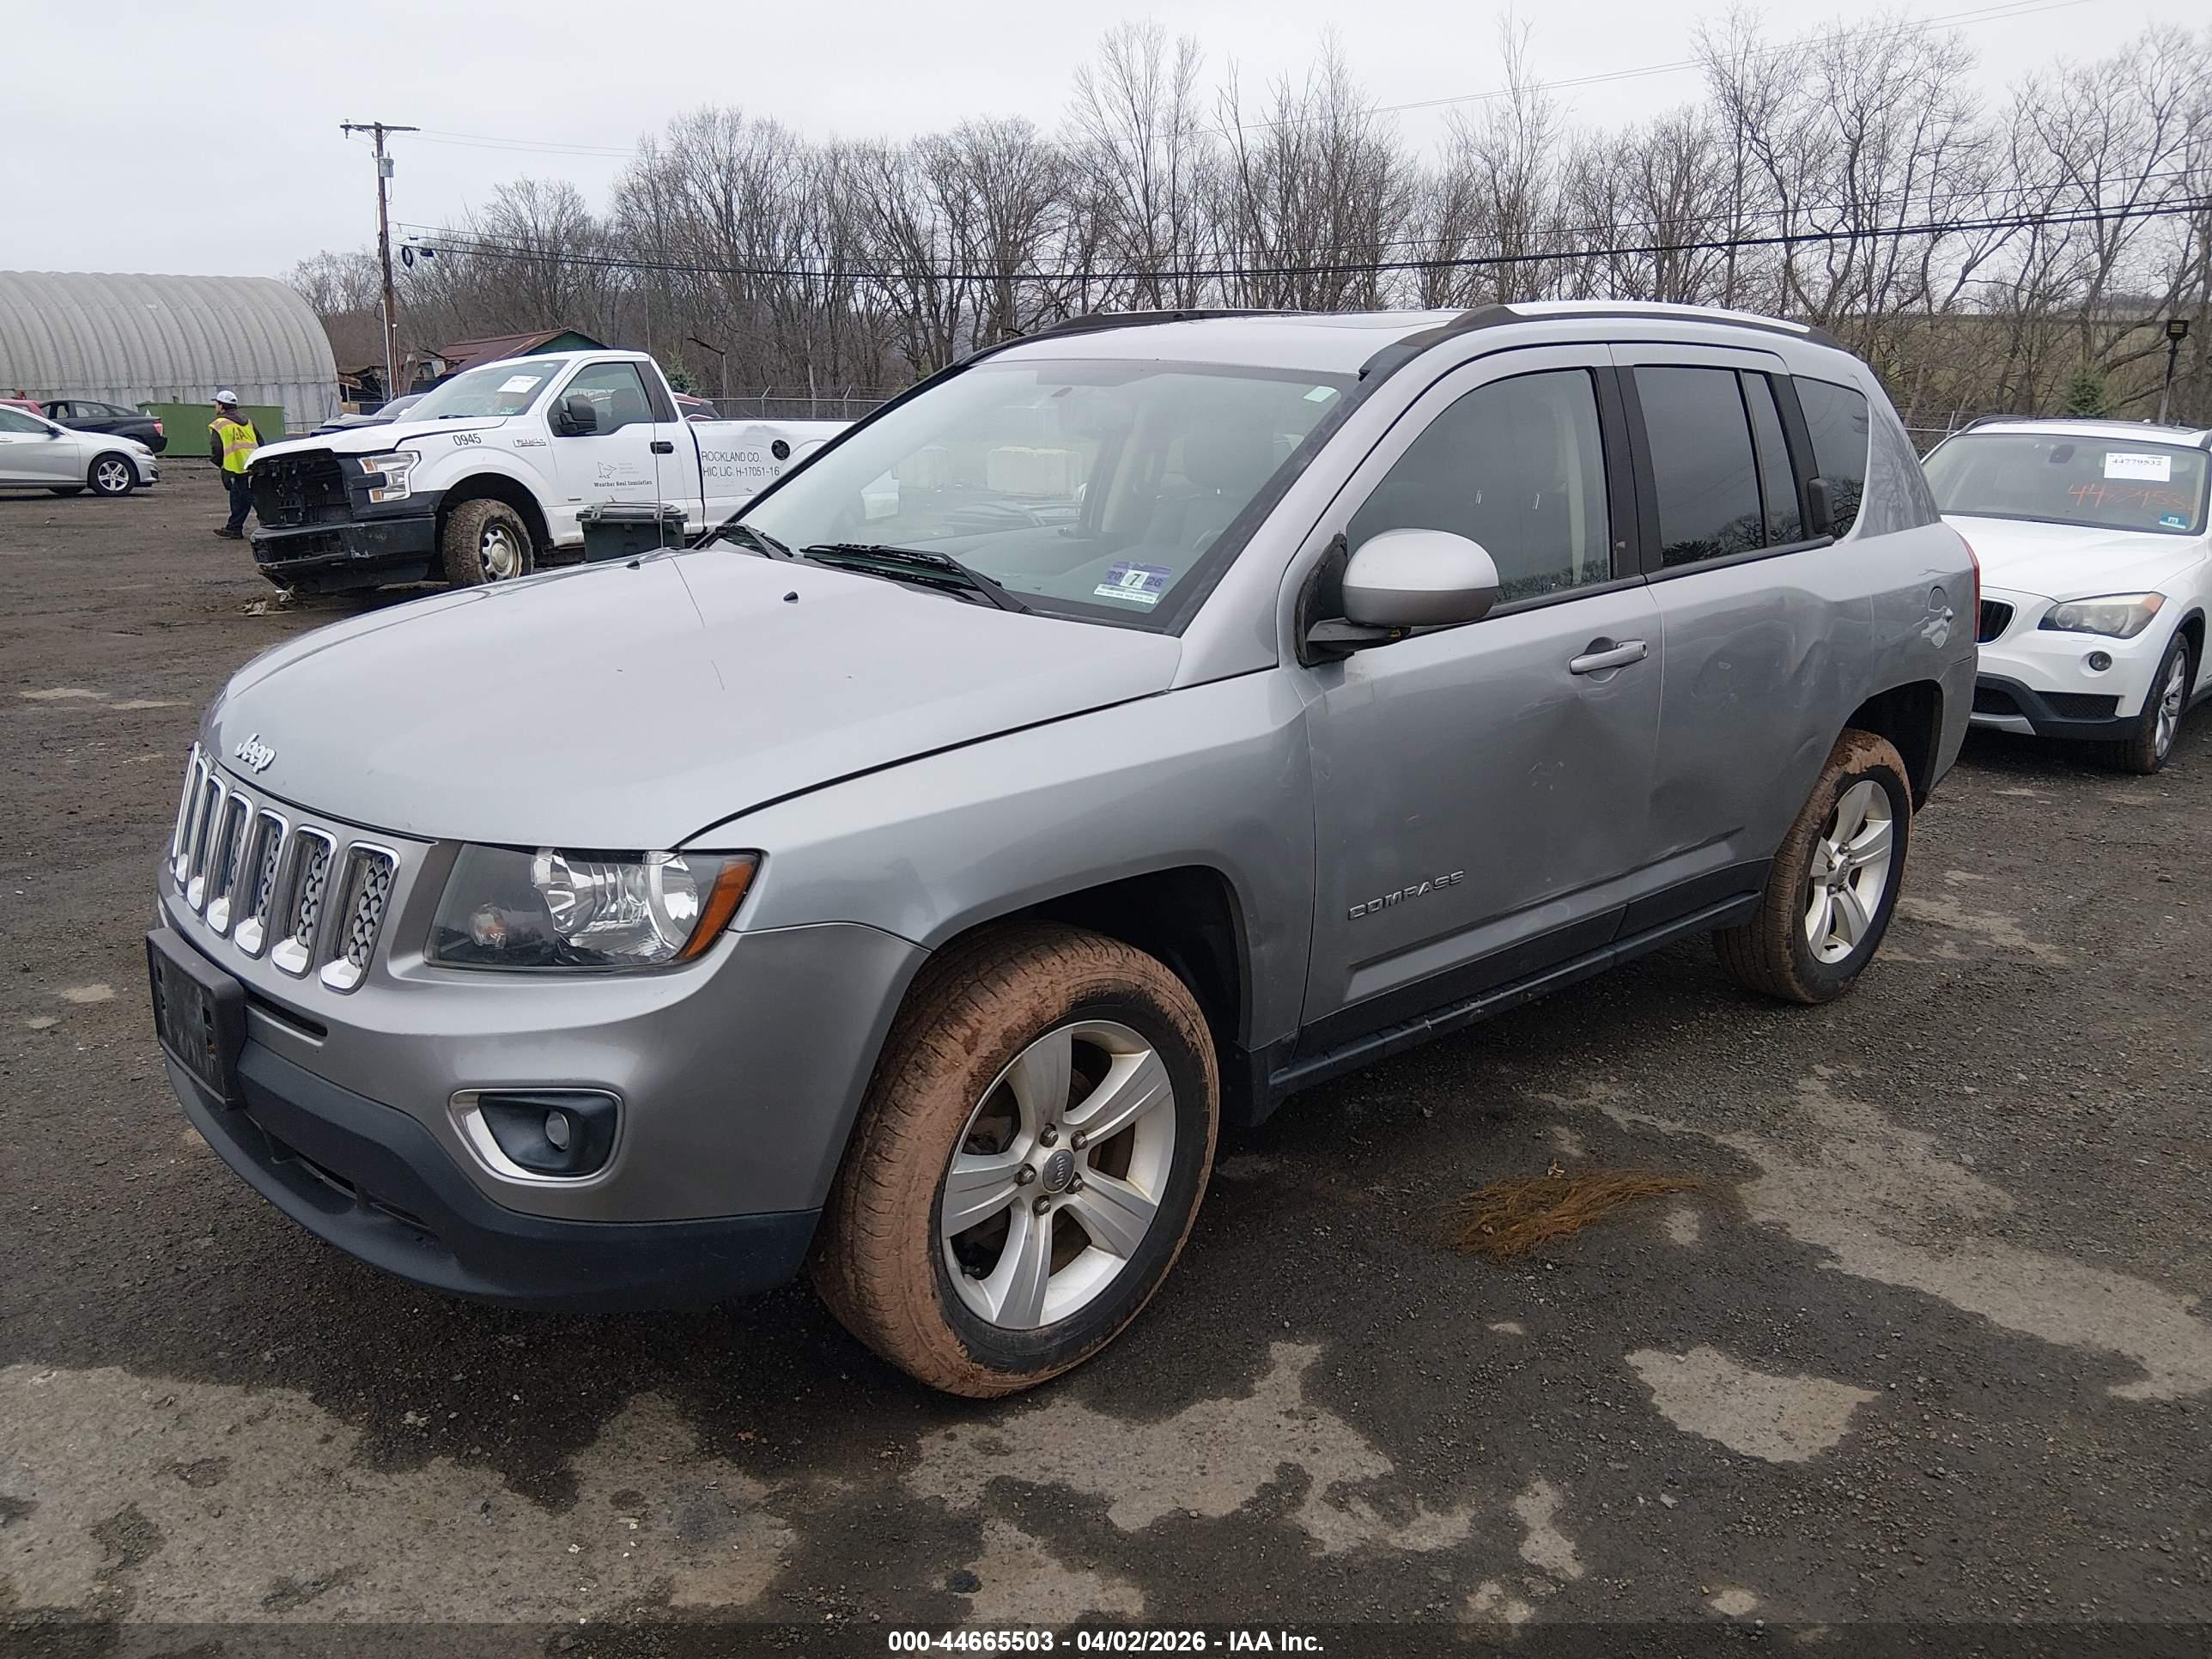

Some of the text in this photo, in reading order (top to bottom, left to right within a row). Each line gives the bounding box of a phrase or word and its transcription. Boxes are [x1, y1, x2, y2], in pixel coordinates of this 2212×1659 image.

[453, 433, 482, 447] 0945
[701, 451, 763, 463] ROCKLAND CO.
[736, 466, 780, 477] H-17051-16
[1129, 573, 1141, 586] 7
[1146, 576, 1163, 586] 26
[234, 732, 276, 774] Jeep
[1348, 870, 1464, 920] COMPASS
